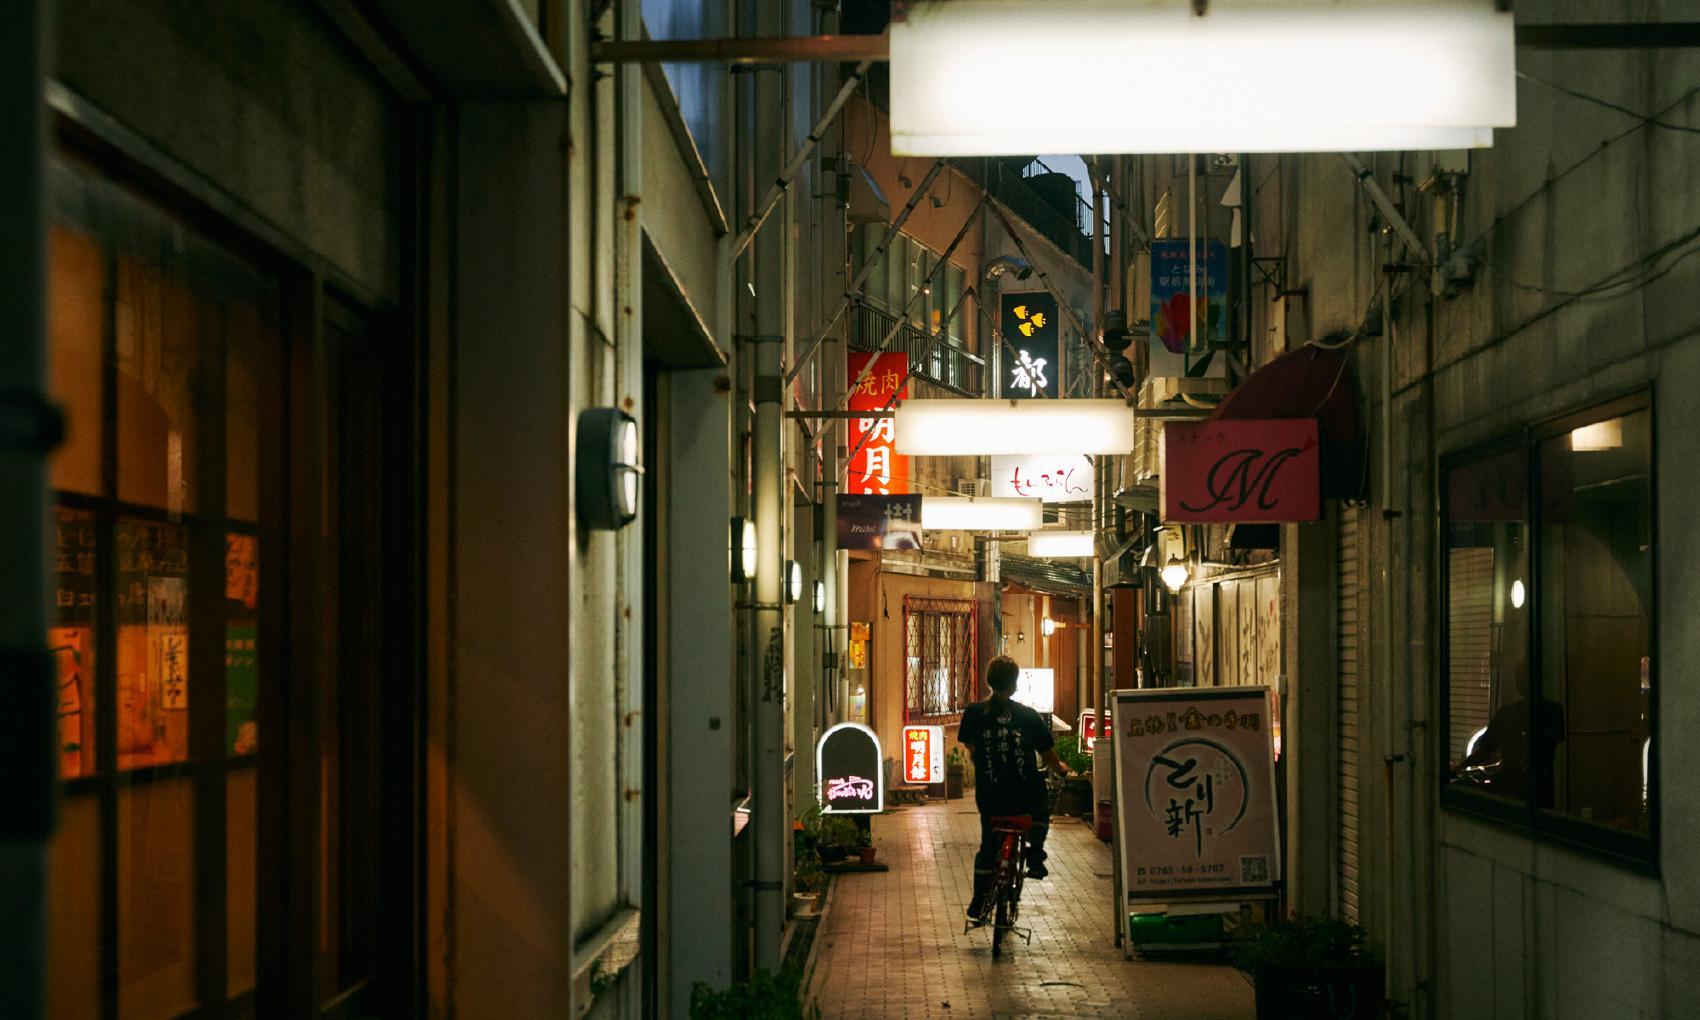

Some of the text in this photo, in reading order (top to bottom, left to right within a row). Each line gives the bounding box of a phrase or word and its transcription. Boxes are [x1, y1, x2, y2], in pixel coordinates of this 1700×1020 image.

[854, 369, 900, 396] 焼肉
[858, 406, 896, 495] 明月
[1178, 448, 1302, 514] M
